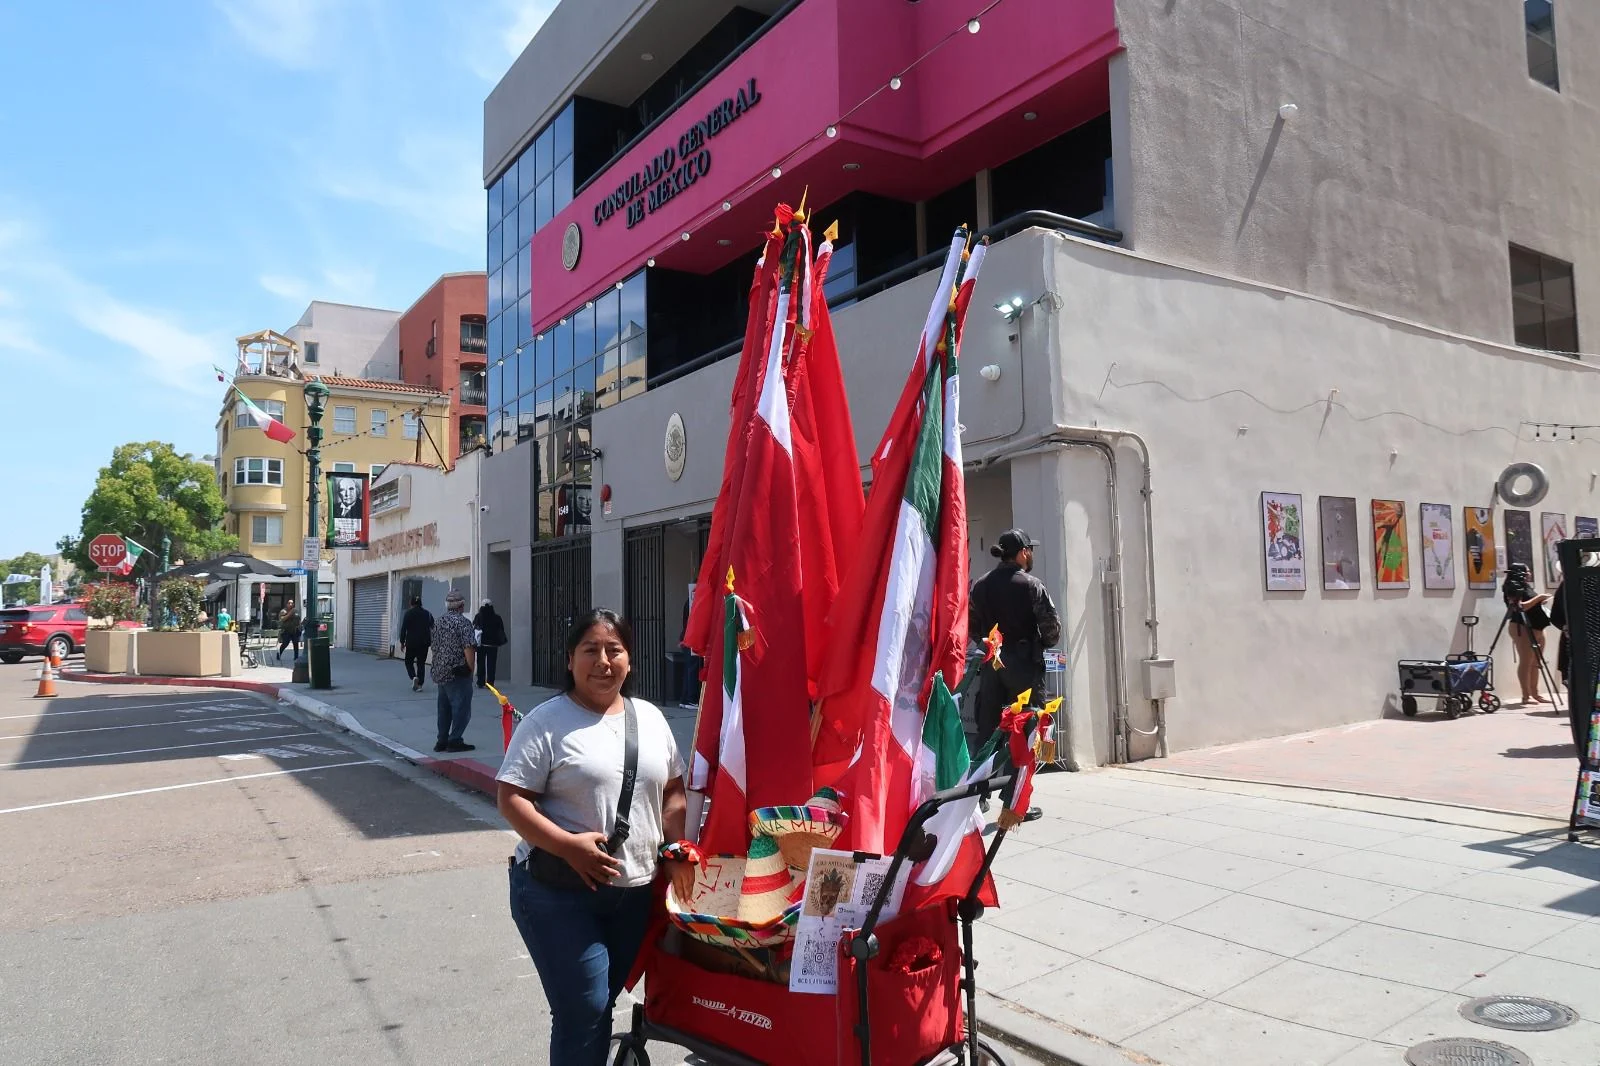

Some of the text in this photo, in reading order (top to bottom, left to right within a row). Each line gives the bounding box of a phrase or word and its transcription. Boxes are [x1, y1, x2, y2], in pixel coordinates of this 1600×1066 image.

[593, 78, 762, 226] CONSULADO GENERAL
[626, 149, 711, 229] DE MEXICO
[92, 544, 125, 557] STOP
[738, 1010, 772, 1031] FLYER
